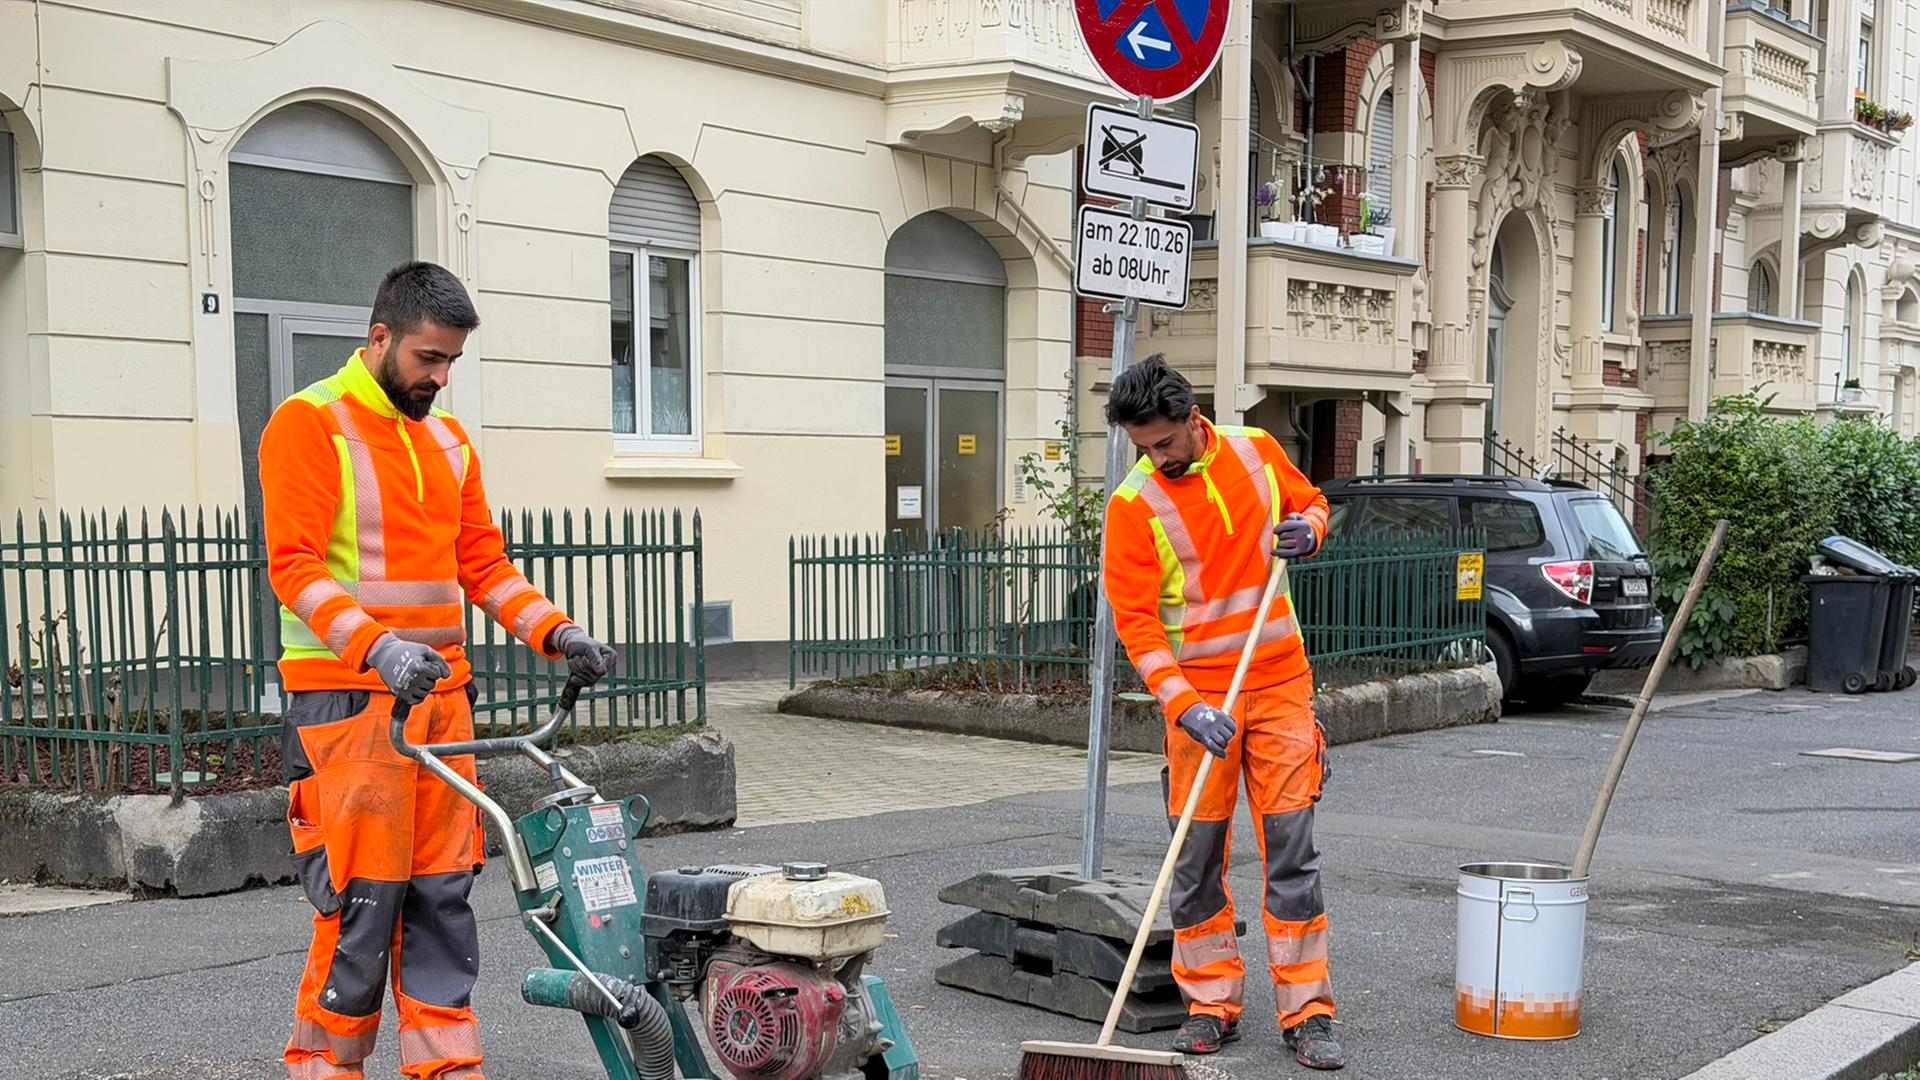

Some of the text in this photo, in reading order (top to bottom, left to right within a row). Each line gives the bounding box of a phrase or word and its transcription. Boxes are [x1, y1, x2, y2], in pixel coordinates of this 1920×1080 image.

[1085, 222, 1184, 254] am 22.10.26
[1092, 253, 1170, 285] ab 08Uhr
[207, 296, 216, 311] 9
[576, 860, 624, 875] WINTER
